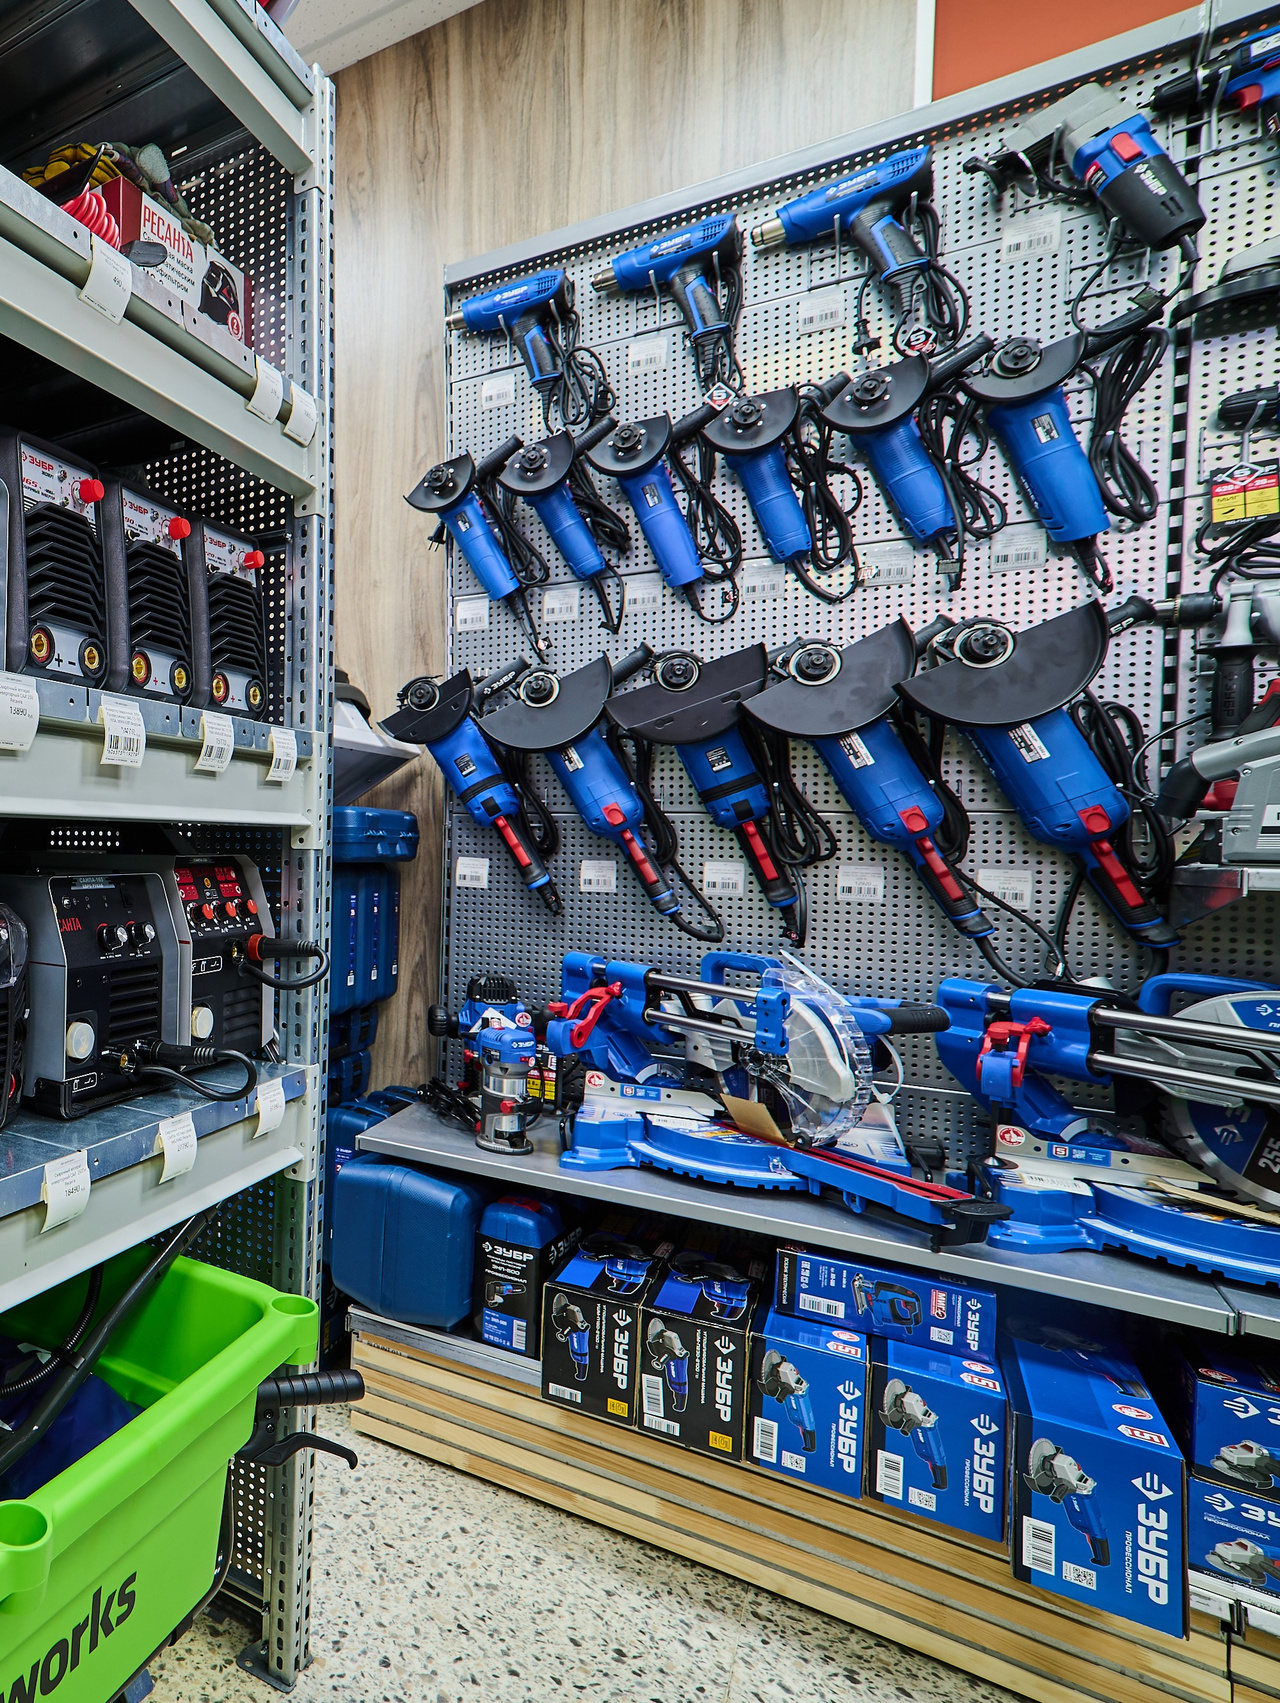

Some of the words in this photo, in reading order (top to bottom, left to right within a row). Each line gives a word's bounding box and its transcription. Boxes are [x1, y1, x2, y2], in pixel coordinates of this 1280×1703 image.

[840, 169, 877, 188] ЗУБР
[1140, 169, 1167, 196] ЗУБР
[143, 204, 194, 263] РЕСАНТА
[660, 233, 691, 250] ЗУБР
[176, 257, 193, 274] маска
[501, 286, 528, 300] ЗУБР
[28, 455, 54, 472] ЗУБР
[128, 501, 149, 516] ЗУБР
[208, 537, 227, 549] ЗУБР
[491, 670, 516, 690] ЗУБР
[518, 1040, 535, 1048] ЗУБР
[1258, 1138, 1280, 1174] 255
[493, 1245, 534, 1261] ЗУБР
[936, 1291, 946, 1310] МИГ
[966, 1311, 981, 1352] ЗУБР
[612, 1328, 630, 1390] ЗУБР
[714, 1356, 734, 1422] ЗУБР
[837, 1402, 858, 1474] ЗУБР
[972, 1437, 996, 1514] ЗУБР
[1124, 1530, 1133, 1594] ПРОФЕССИОНАЛ
[1137, 1503, 1169, 1606] ЗУБР
